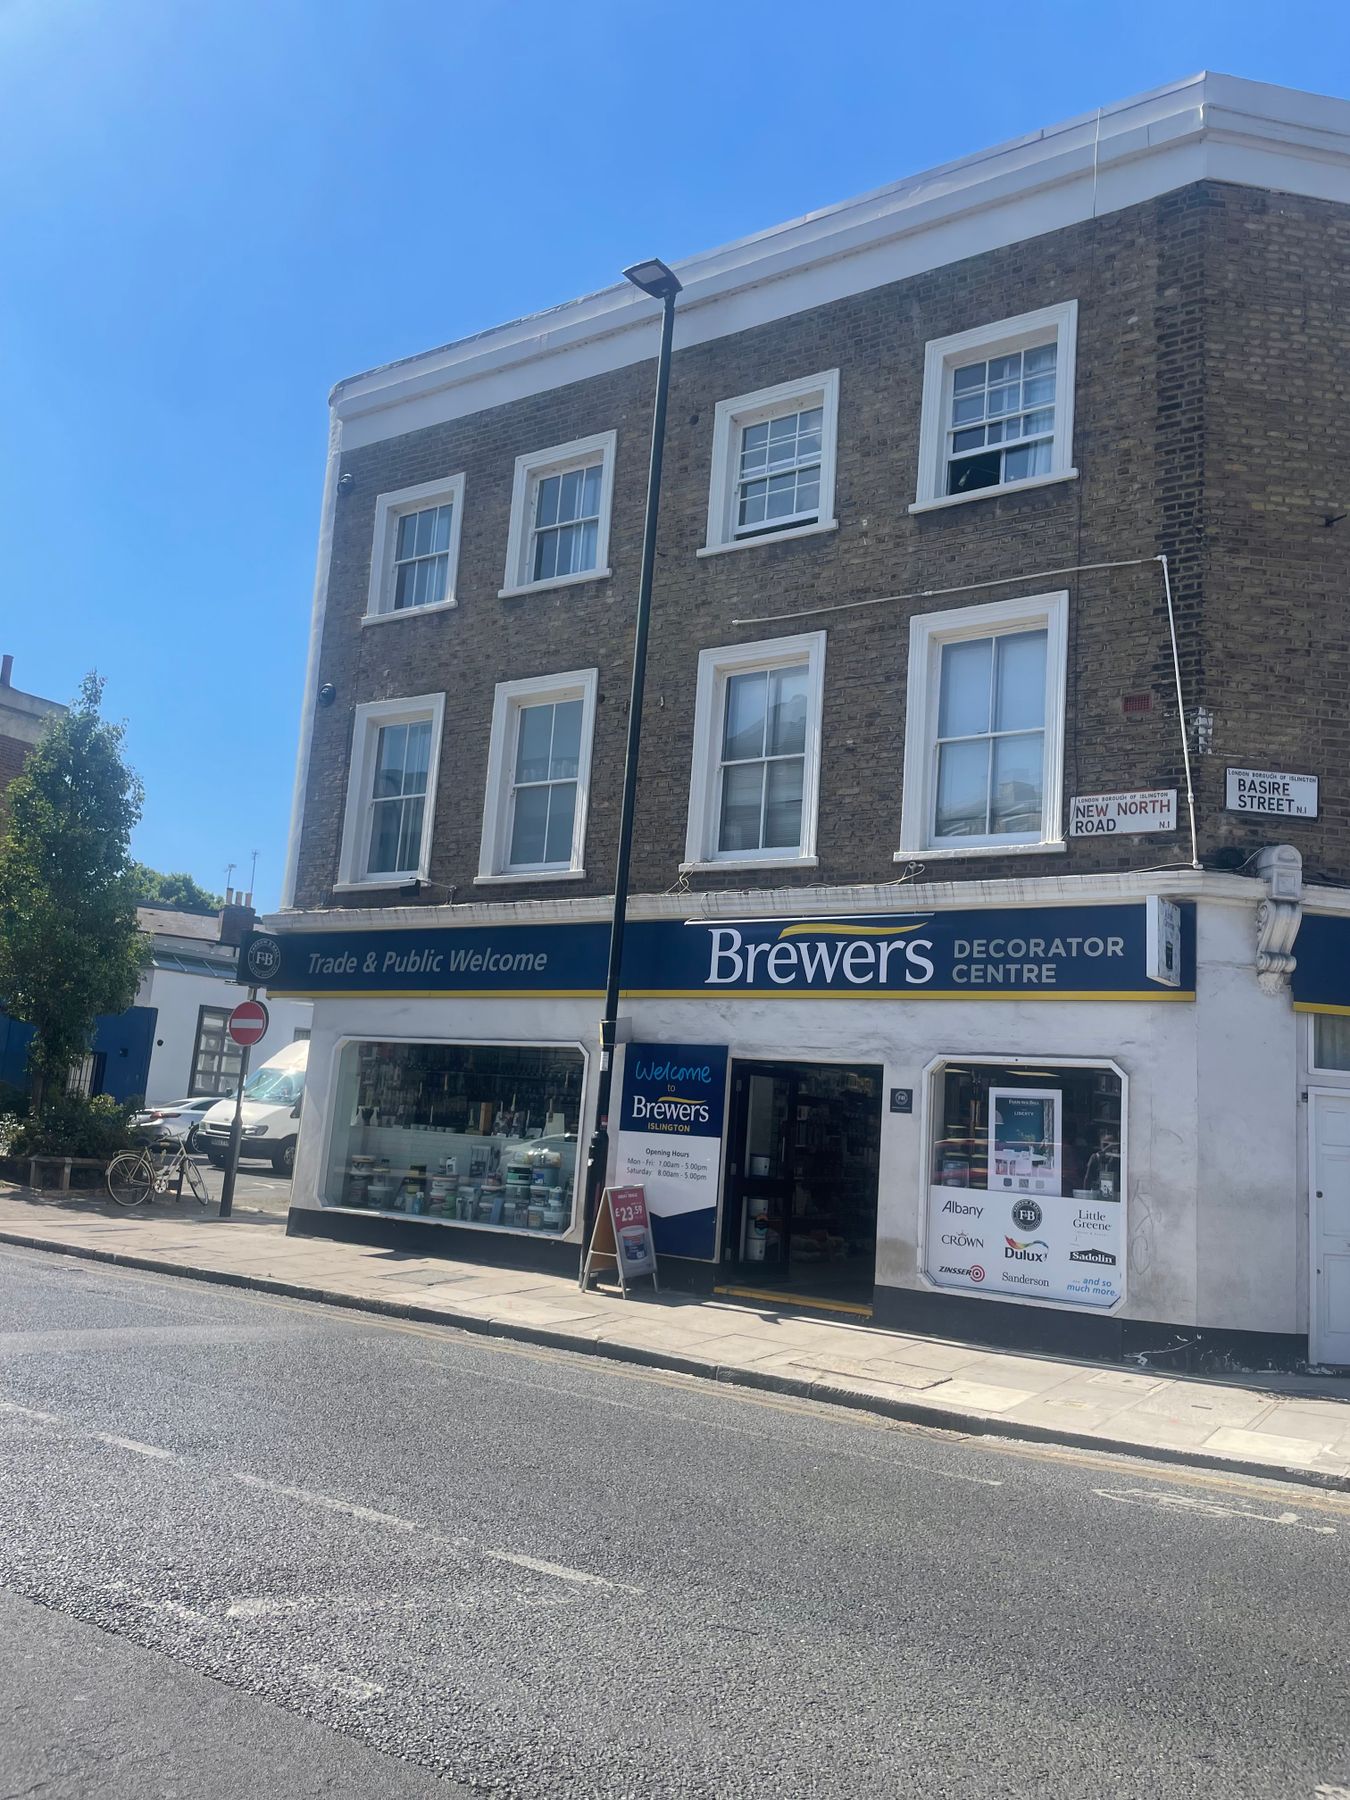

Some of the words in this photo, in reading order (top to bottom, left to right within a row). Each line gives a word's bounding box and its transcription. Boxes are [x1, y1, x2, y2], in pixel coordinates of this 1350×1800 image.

[1228, 769, 1250, 777] LONDON
[1289, 776, 1317, 784] ISLINGTON
[1238, 778, 1291, 797] BASIRE
[1078, 796, 1099, 804] LONDON
[1139, 791, 1169, 799] ISLINGTON
[1238, 794, 1295, 813] STREET
[1075, 803, 1109, 819] NEW
[1117, 799, 1171, 816] NORTH
[1075, 818, 1117, 834] ROAD
[953, 936, 1125, 958] DECORATOR
[308, 951, 357, 974] Trade
[362, 951, 378, 973] &
[382, 949, 443, 973] Public
[449, 947, 548, 972] Welcome
[704, 927, 935, 984] Brewers
[951, 963, 1058, 983] CENTRE
[635, 1060, 712, 1083] Welcome
[667, 1084, 676, 1092] to
[632, 1095, 709, 1122] Brewers
[648, 1122, 690, 1132] ISLINGTON
[645, 1147, 671, 1157] Opening
[942, 1200, 984, 1219] Albany
[1079, 1209, 1106, 1221] Little
[1073, 1218, 1111, 1232] Greene
[941, 1234, 984, 1248] CROWN
[1004, 1247, 1043, 1262] Dulux
[1072, 1252, 1113, 1264] Sadolin
[939, 1266, 972, 1276] ZINSSER
[1002, 1272, 1050, 1287] Sanderson
[1083, 1277, 1101, 1286] and
[1067, 1283, 1091, 1293] much
